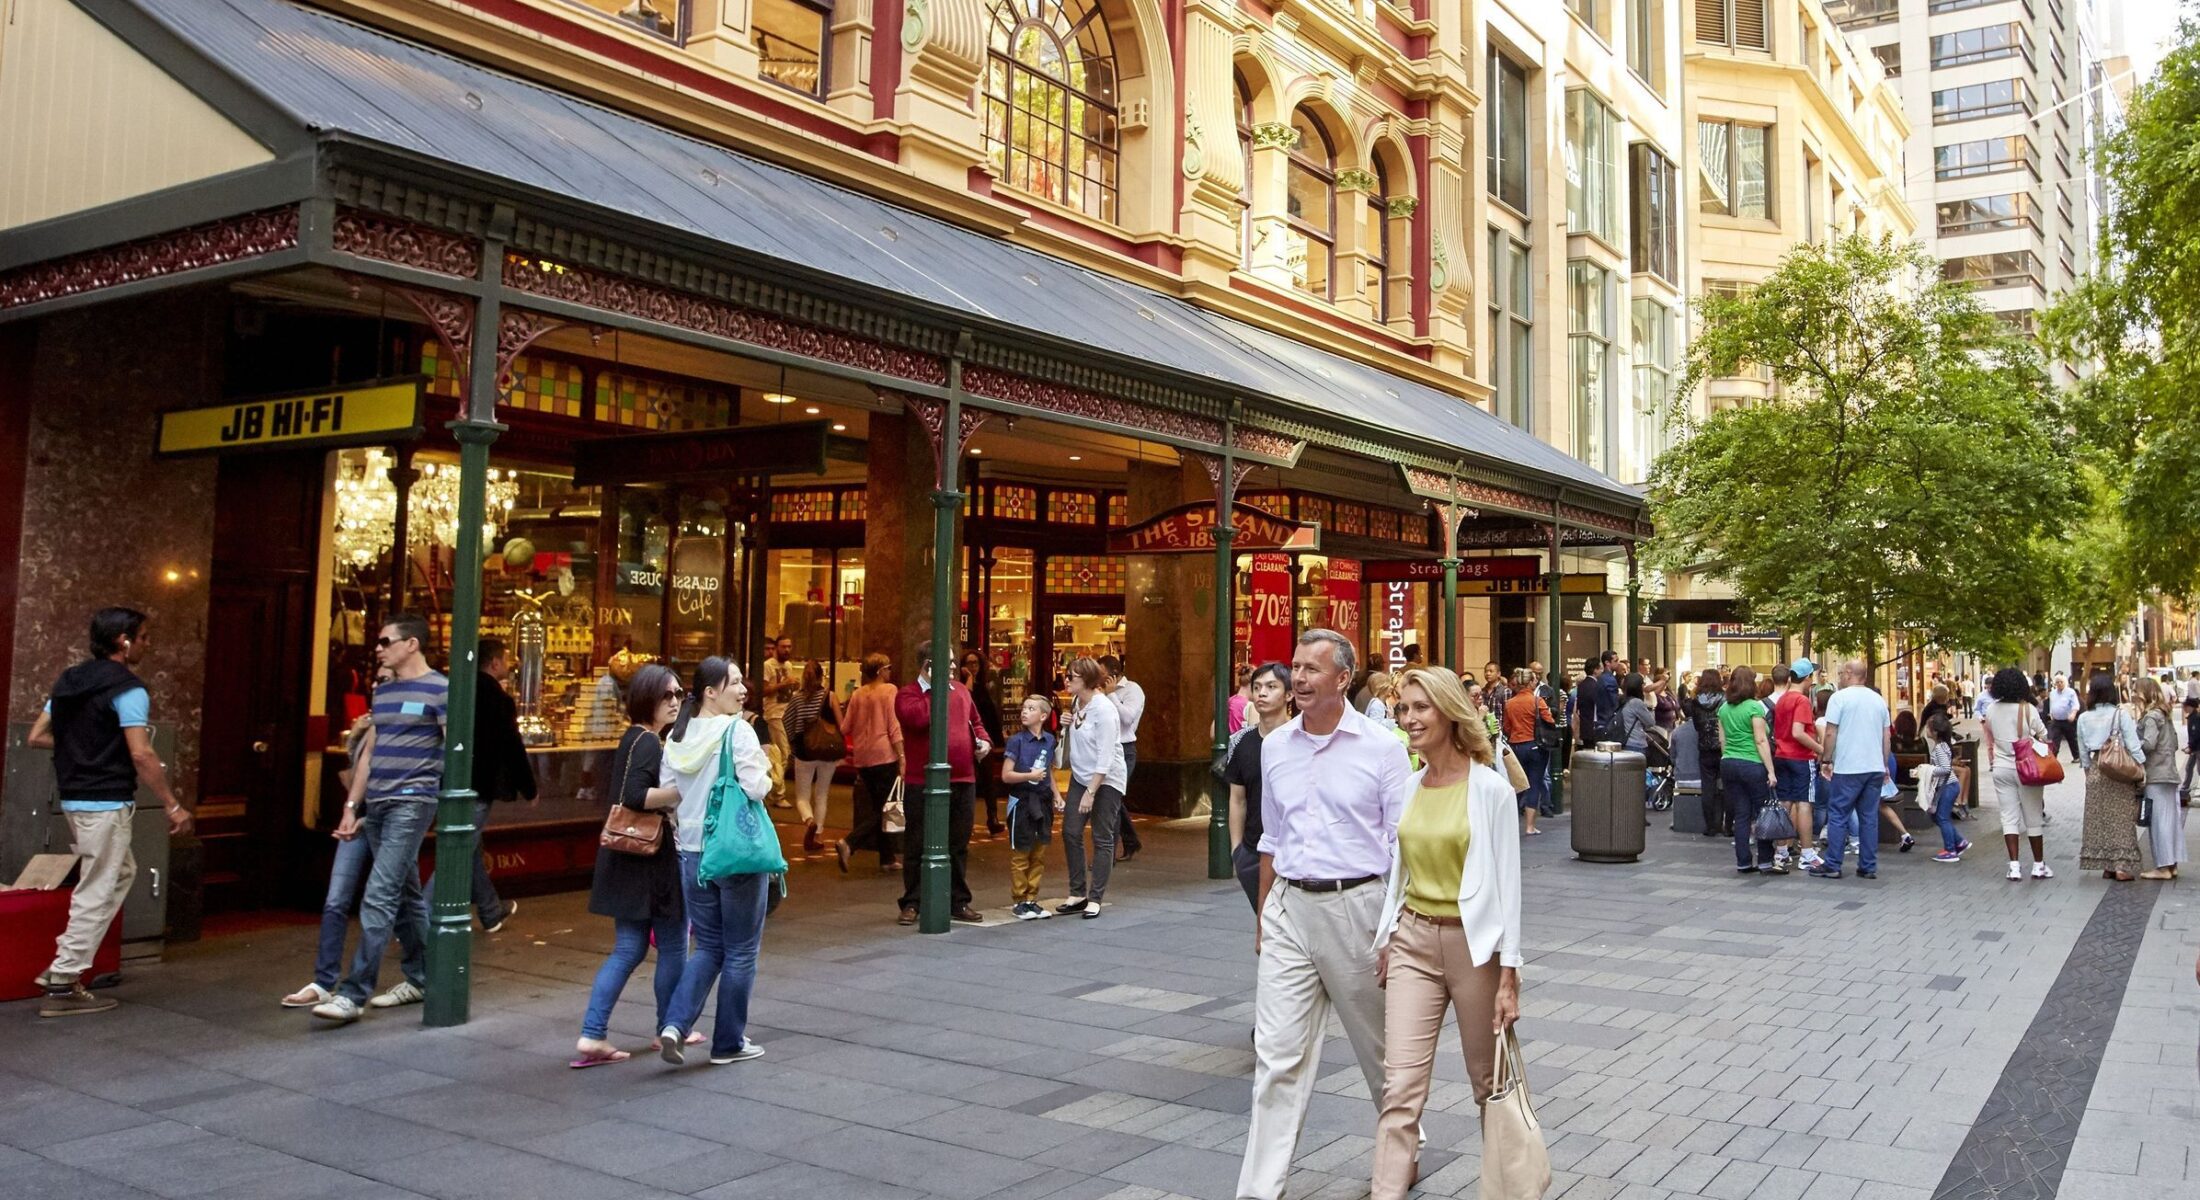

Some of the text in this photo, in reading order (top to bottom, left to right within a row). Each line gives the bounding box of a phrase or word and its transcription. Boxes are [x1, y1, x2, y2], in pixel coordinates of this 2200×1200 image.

[222, 407, 265, 441] JB
[1127, 521, 1177, 549] THE
[1255, 562, 1289, 574] CLEARANC
[1409, 562, 1489, 577] Strabags
[1486, 579, 1513, 592] JB
[599, 607, 633, 625] BON
[1279, 616, 1290, 627] OFF
